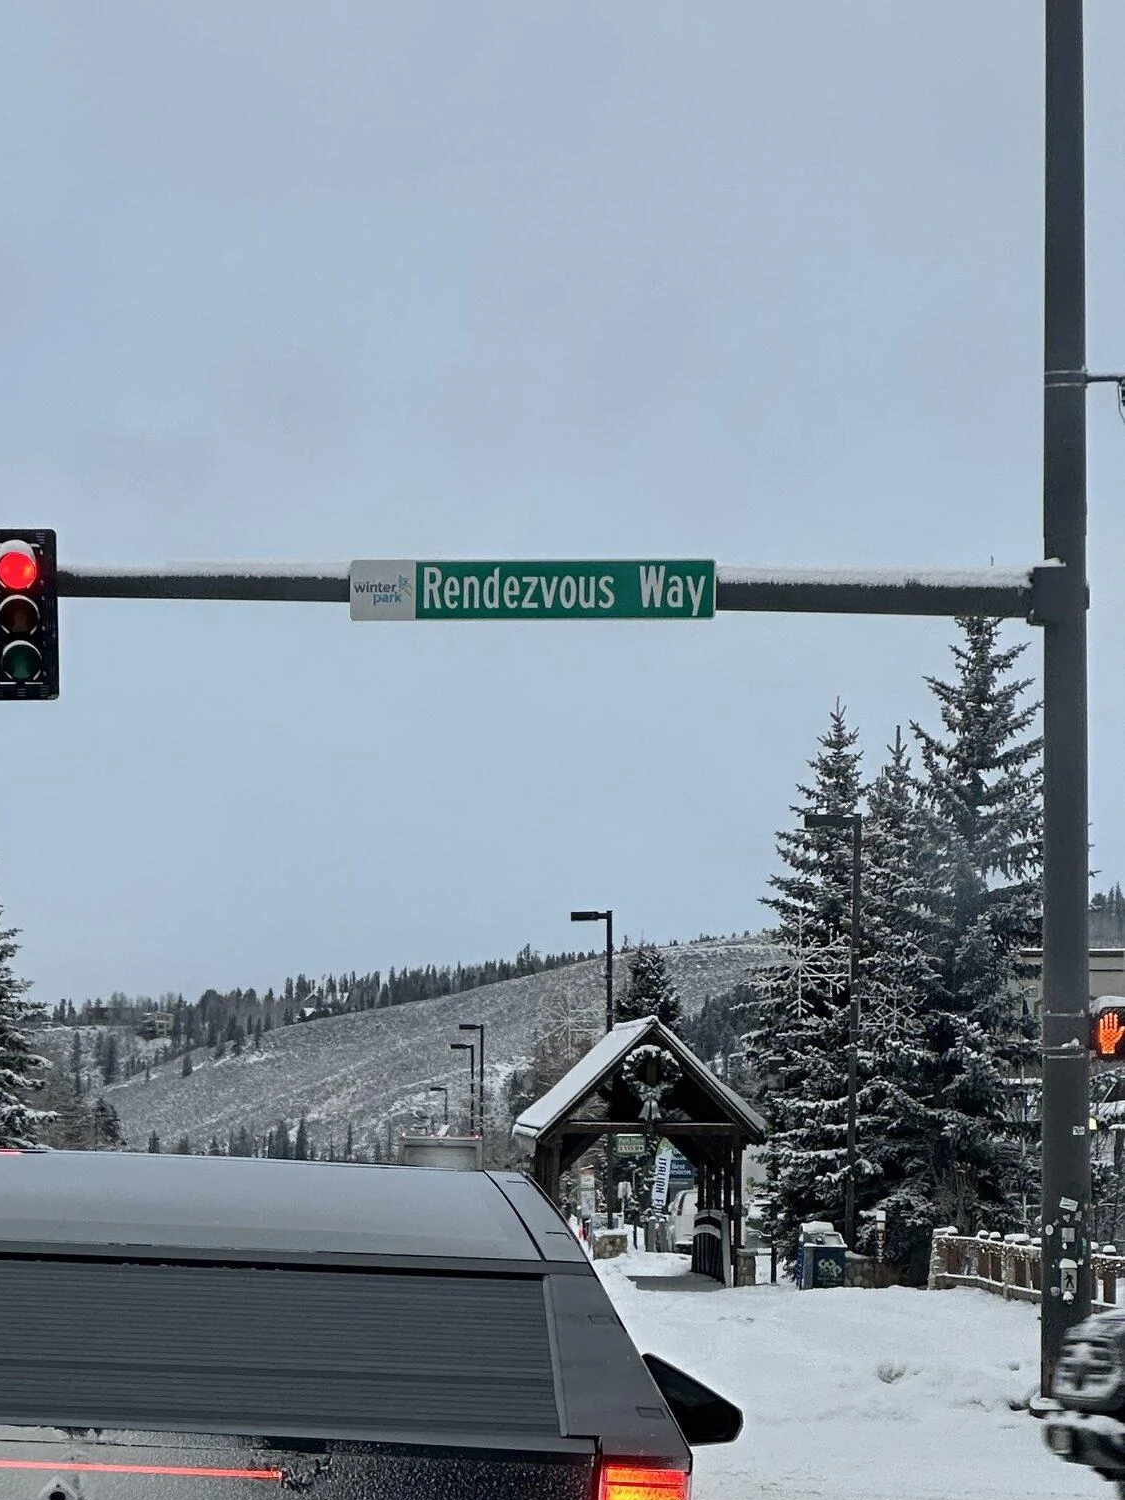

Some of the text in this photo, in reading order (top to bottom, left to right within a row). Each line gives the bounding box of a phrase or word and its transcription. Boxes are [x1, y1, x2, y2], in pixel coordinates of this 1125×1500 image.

[353, 582, 397, 595] winter
[372, 591, 402, 606] park
[423, 565, 707, 616] Rendezvous Way
[656, 1157, 667, 1194] ITALIAN
